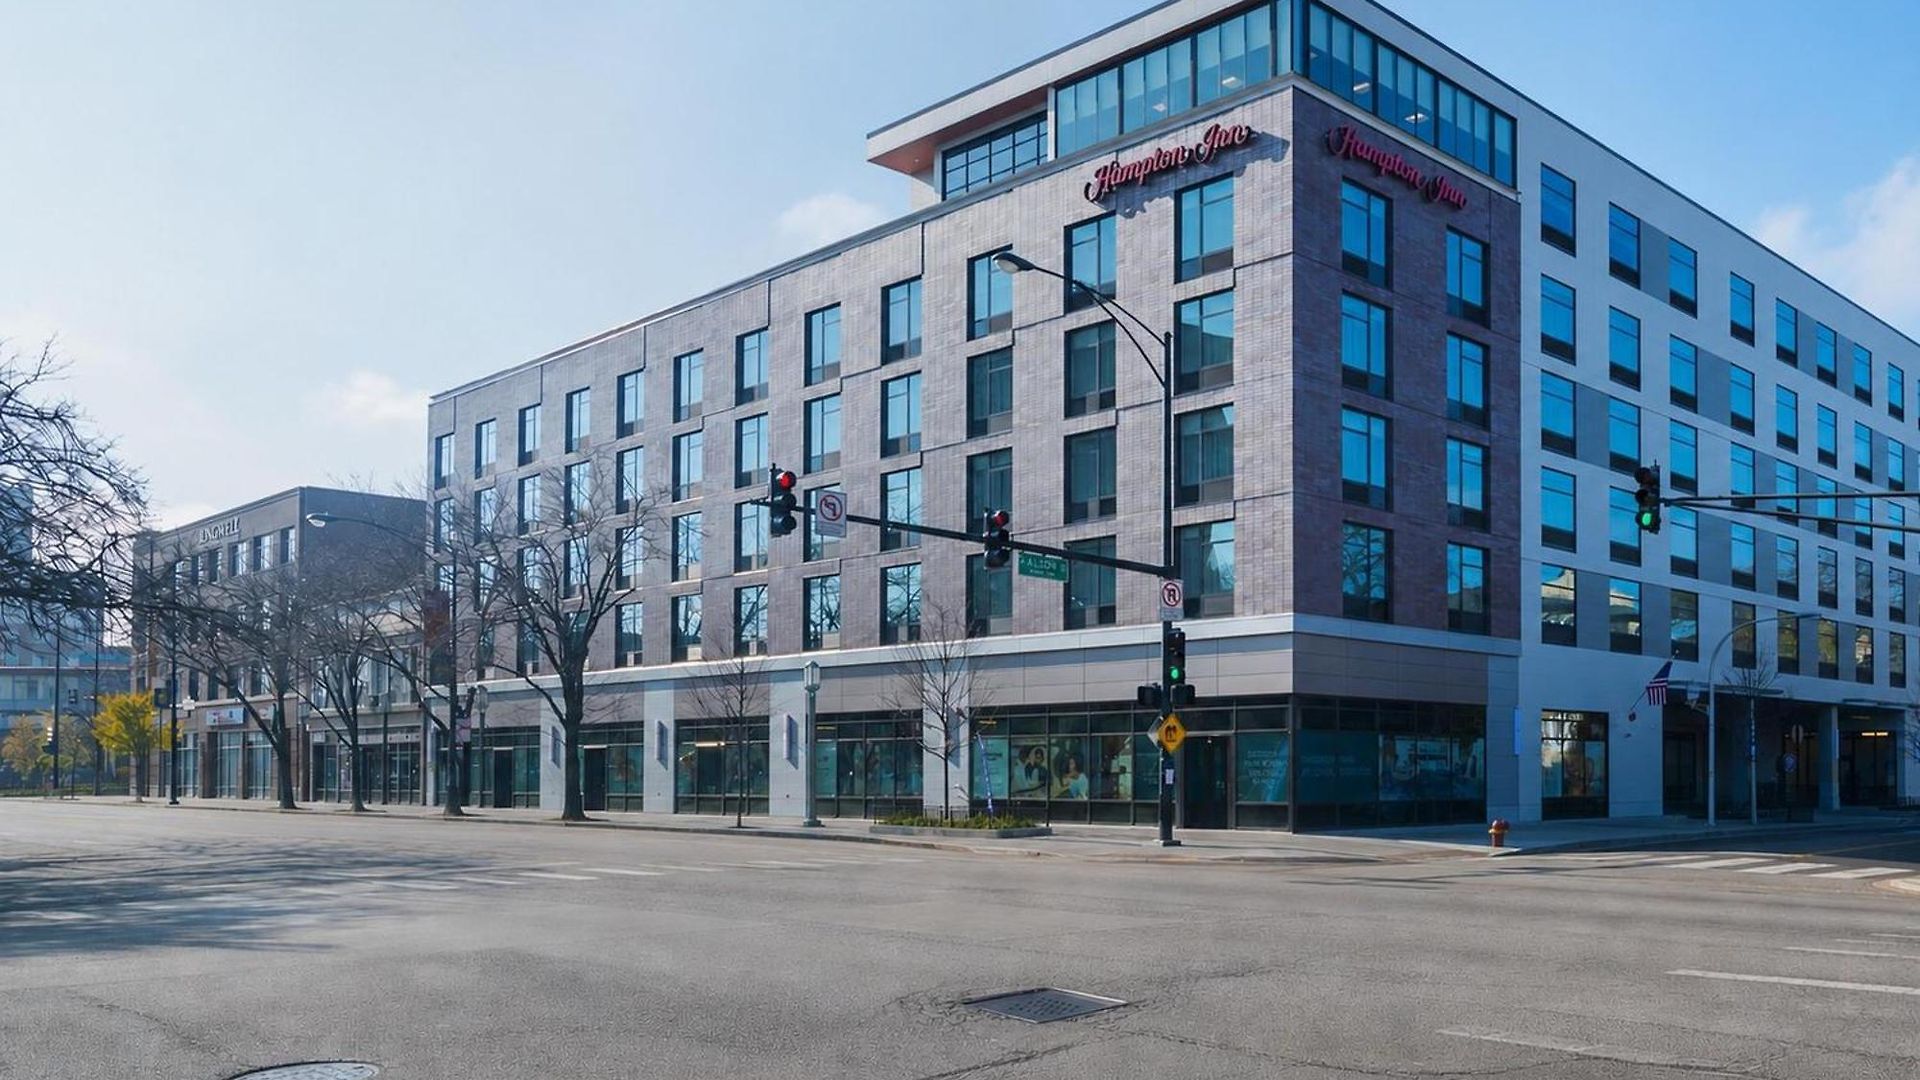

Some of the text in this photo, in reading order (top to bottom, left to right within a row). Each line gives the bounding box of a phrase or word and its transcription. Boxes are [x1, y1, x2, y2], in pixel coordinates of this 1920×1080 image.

[1085, 123, 1251, 201] Hampton Inn
[1328, 124, 1467, 209] Hampton Inn
